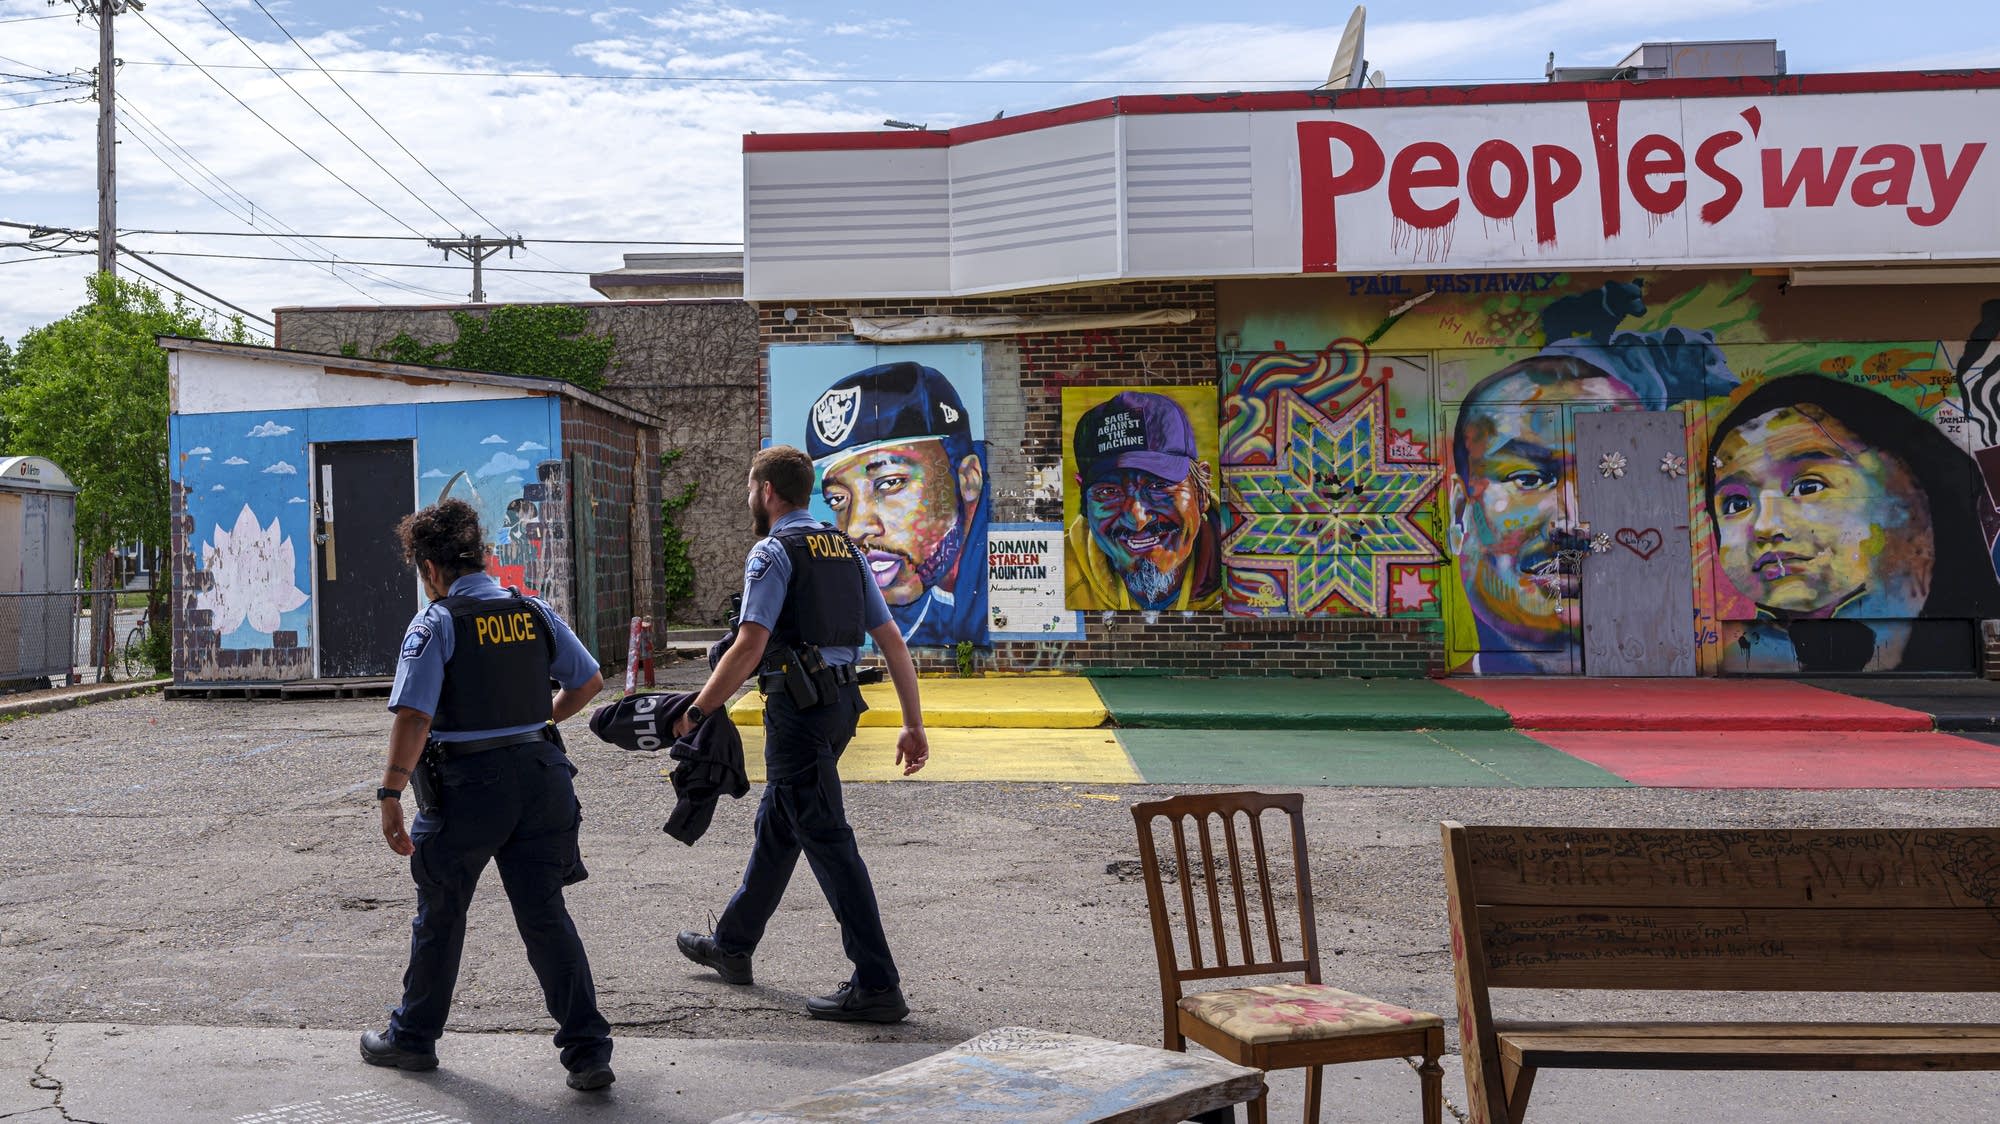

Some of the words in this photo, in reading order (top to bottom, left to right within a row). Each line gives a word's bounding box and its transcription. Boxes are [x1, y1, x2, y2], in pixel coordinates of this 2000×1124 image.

[1297, 100, 1762, 272] Peoples'
[1761, 142, 1987, 226] way
[1346, 275, 1412, 296] PAUL
[1439, 316, 1462, 333] My
[1104, 412, 1130, 425] SAGE
[1097, 419, 1140, 437] AGAINST
[1107, 429, 1127, 441] THE
[1098, 436, 1144, 453] MACHINE
[989, 541, 1048, 554] DONAVAN
[989, 554, 1039, 566] STARLEN
[989, 566, 1048, 579] MOUNTAIN
[475, 613, 536, 645] POLICE
[633, 695, 662, 750] OLIC
